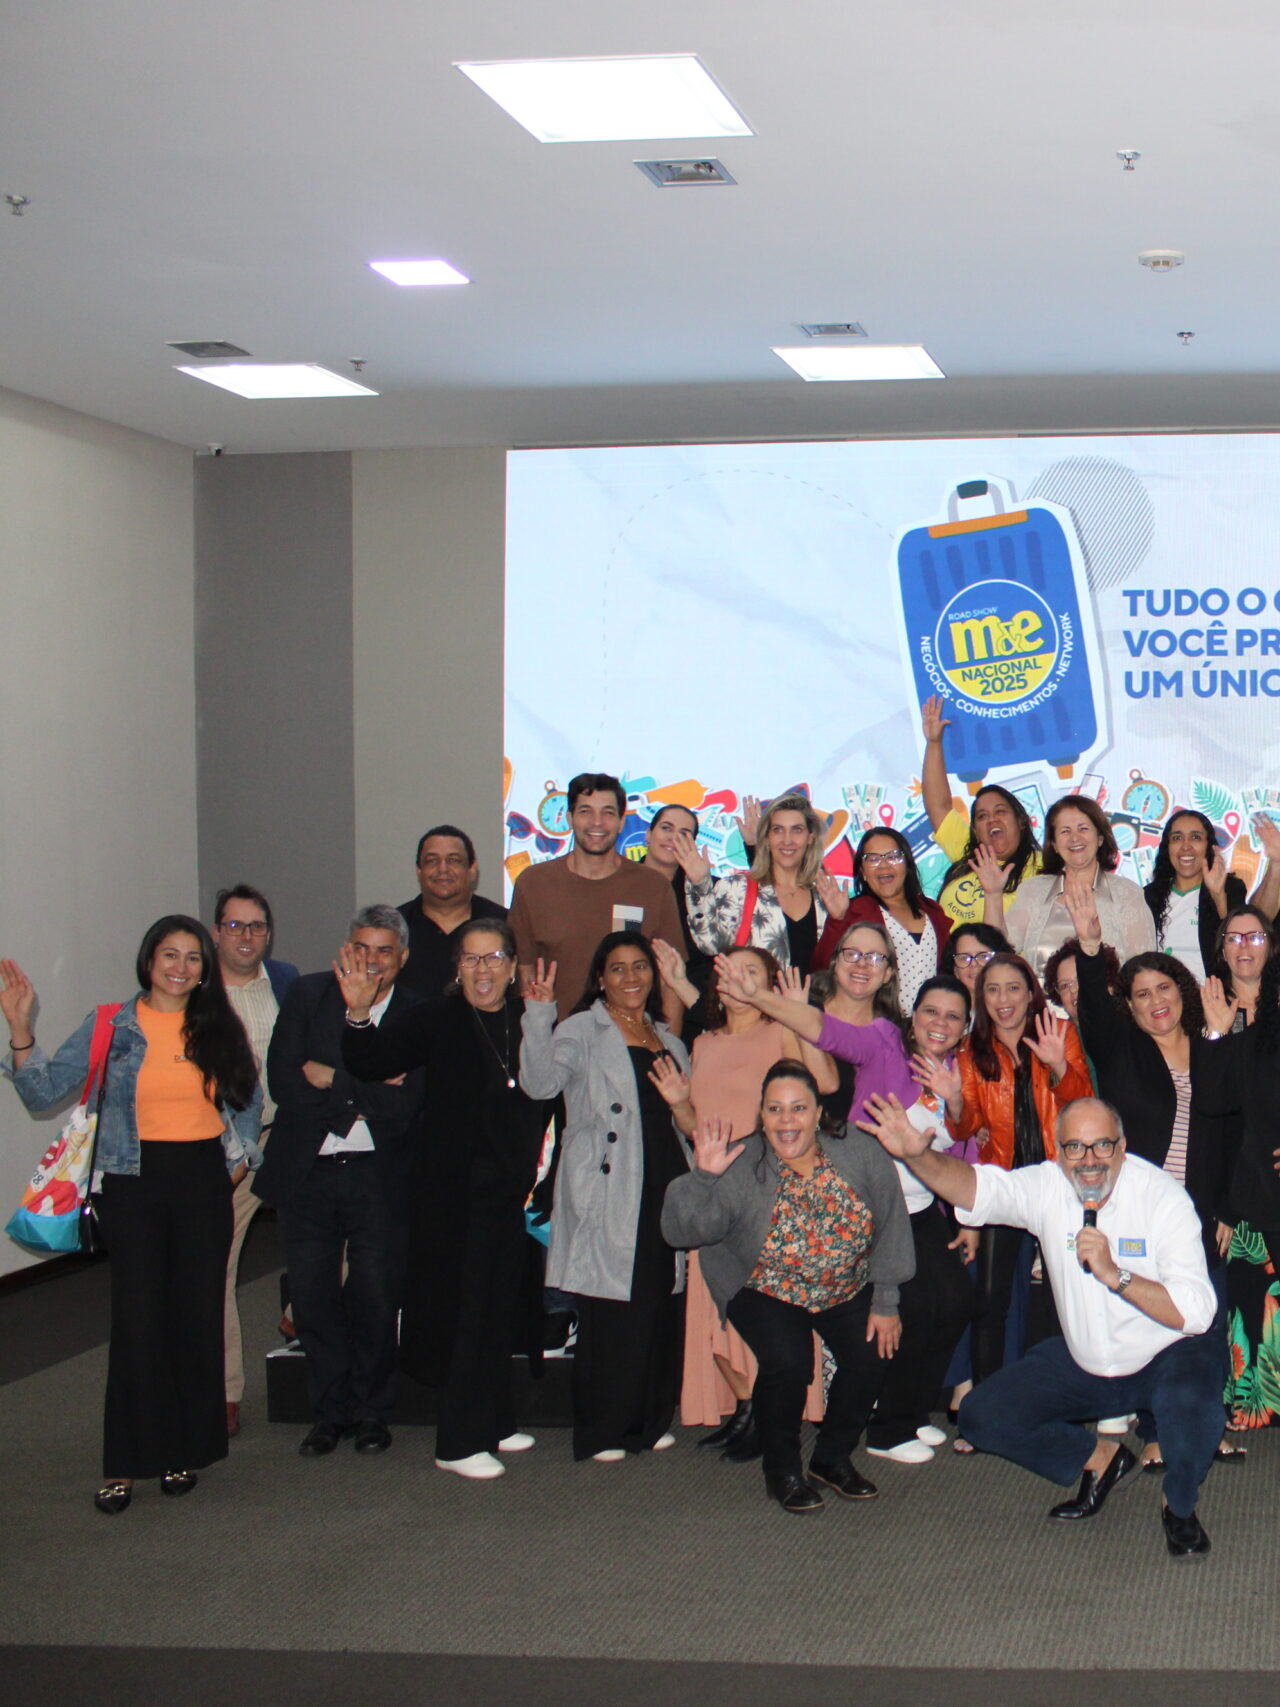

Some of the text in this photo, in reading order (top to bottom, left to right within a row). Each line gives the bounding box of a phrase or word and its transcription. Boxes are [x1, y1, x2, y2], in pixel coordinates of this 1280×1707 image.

[948, 606, 998, 622] ROAD SHOW
[1122, 587, 1230, 617] TUDO
[1236, 587, 1267, 616] O
[1122, 620, 1228, 658] VOCÊ
[920, 611, 1075, 718] NEGÓCIOS CONHECIMENTOS NETWORK
[960, 657, 1043, 683] NACIONAL
[979, 673, 1029, 697] 2025
[1124, 670, 1183, 699] UM
[947, 902, 976, 919] AGENTES
